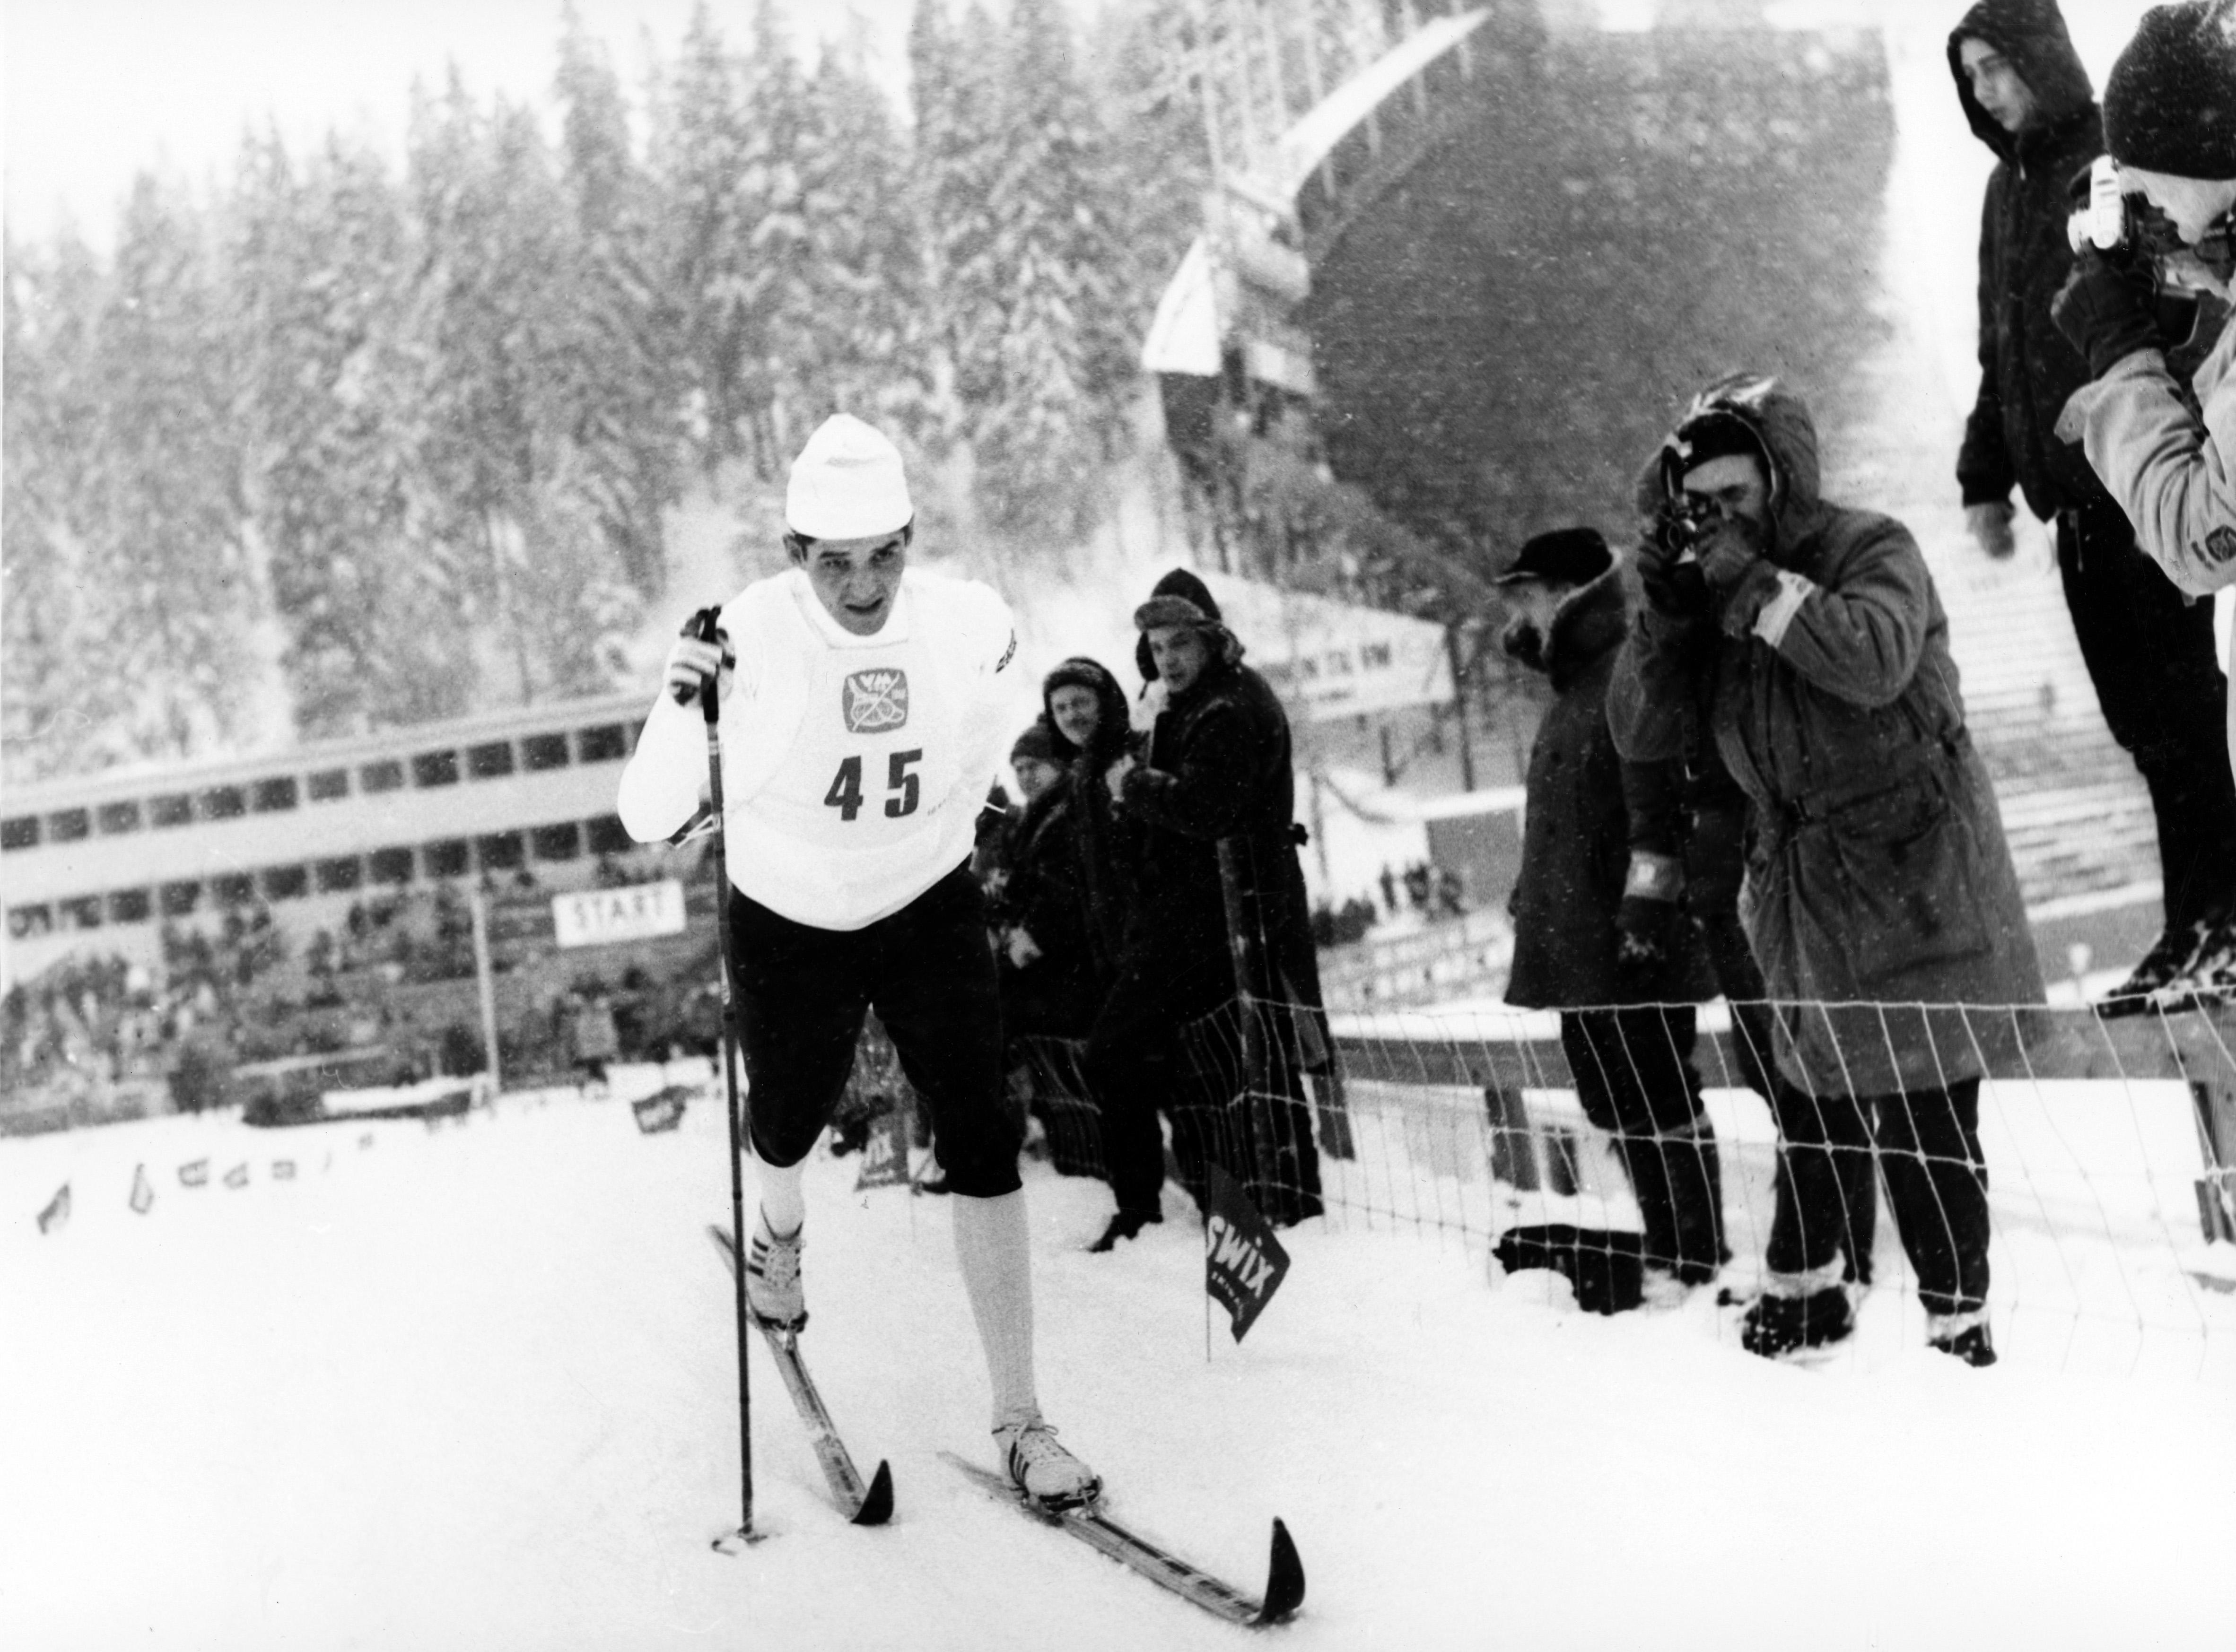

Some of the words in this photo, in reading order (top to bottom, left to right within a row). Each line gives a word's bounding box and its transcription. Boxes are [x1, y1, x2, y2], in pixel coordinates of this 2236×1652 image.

[824, 748, 923, 821] 45
[572, 886, 669, 930] START
[1206, 1214, 1275, 1300] SWIX
